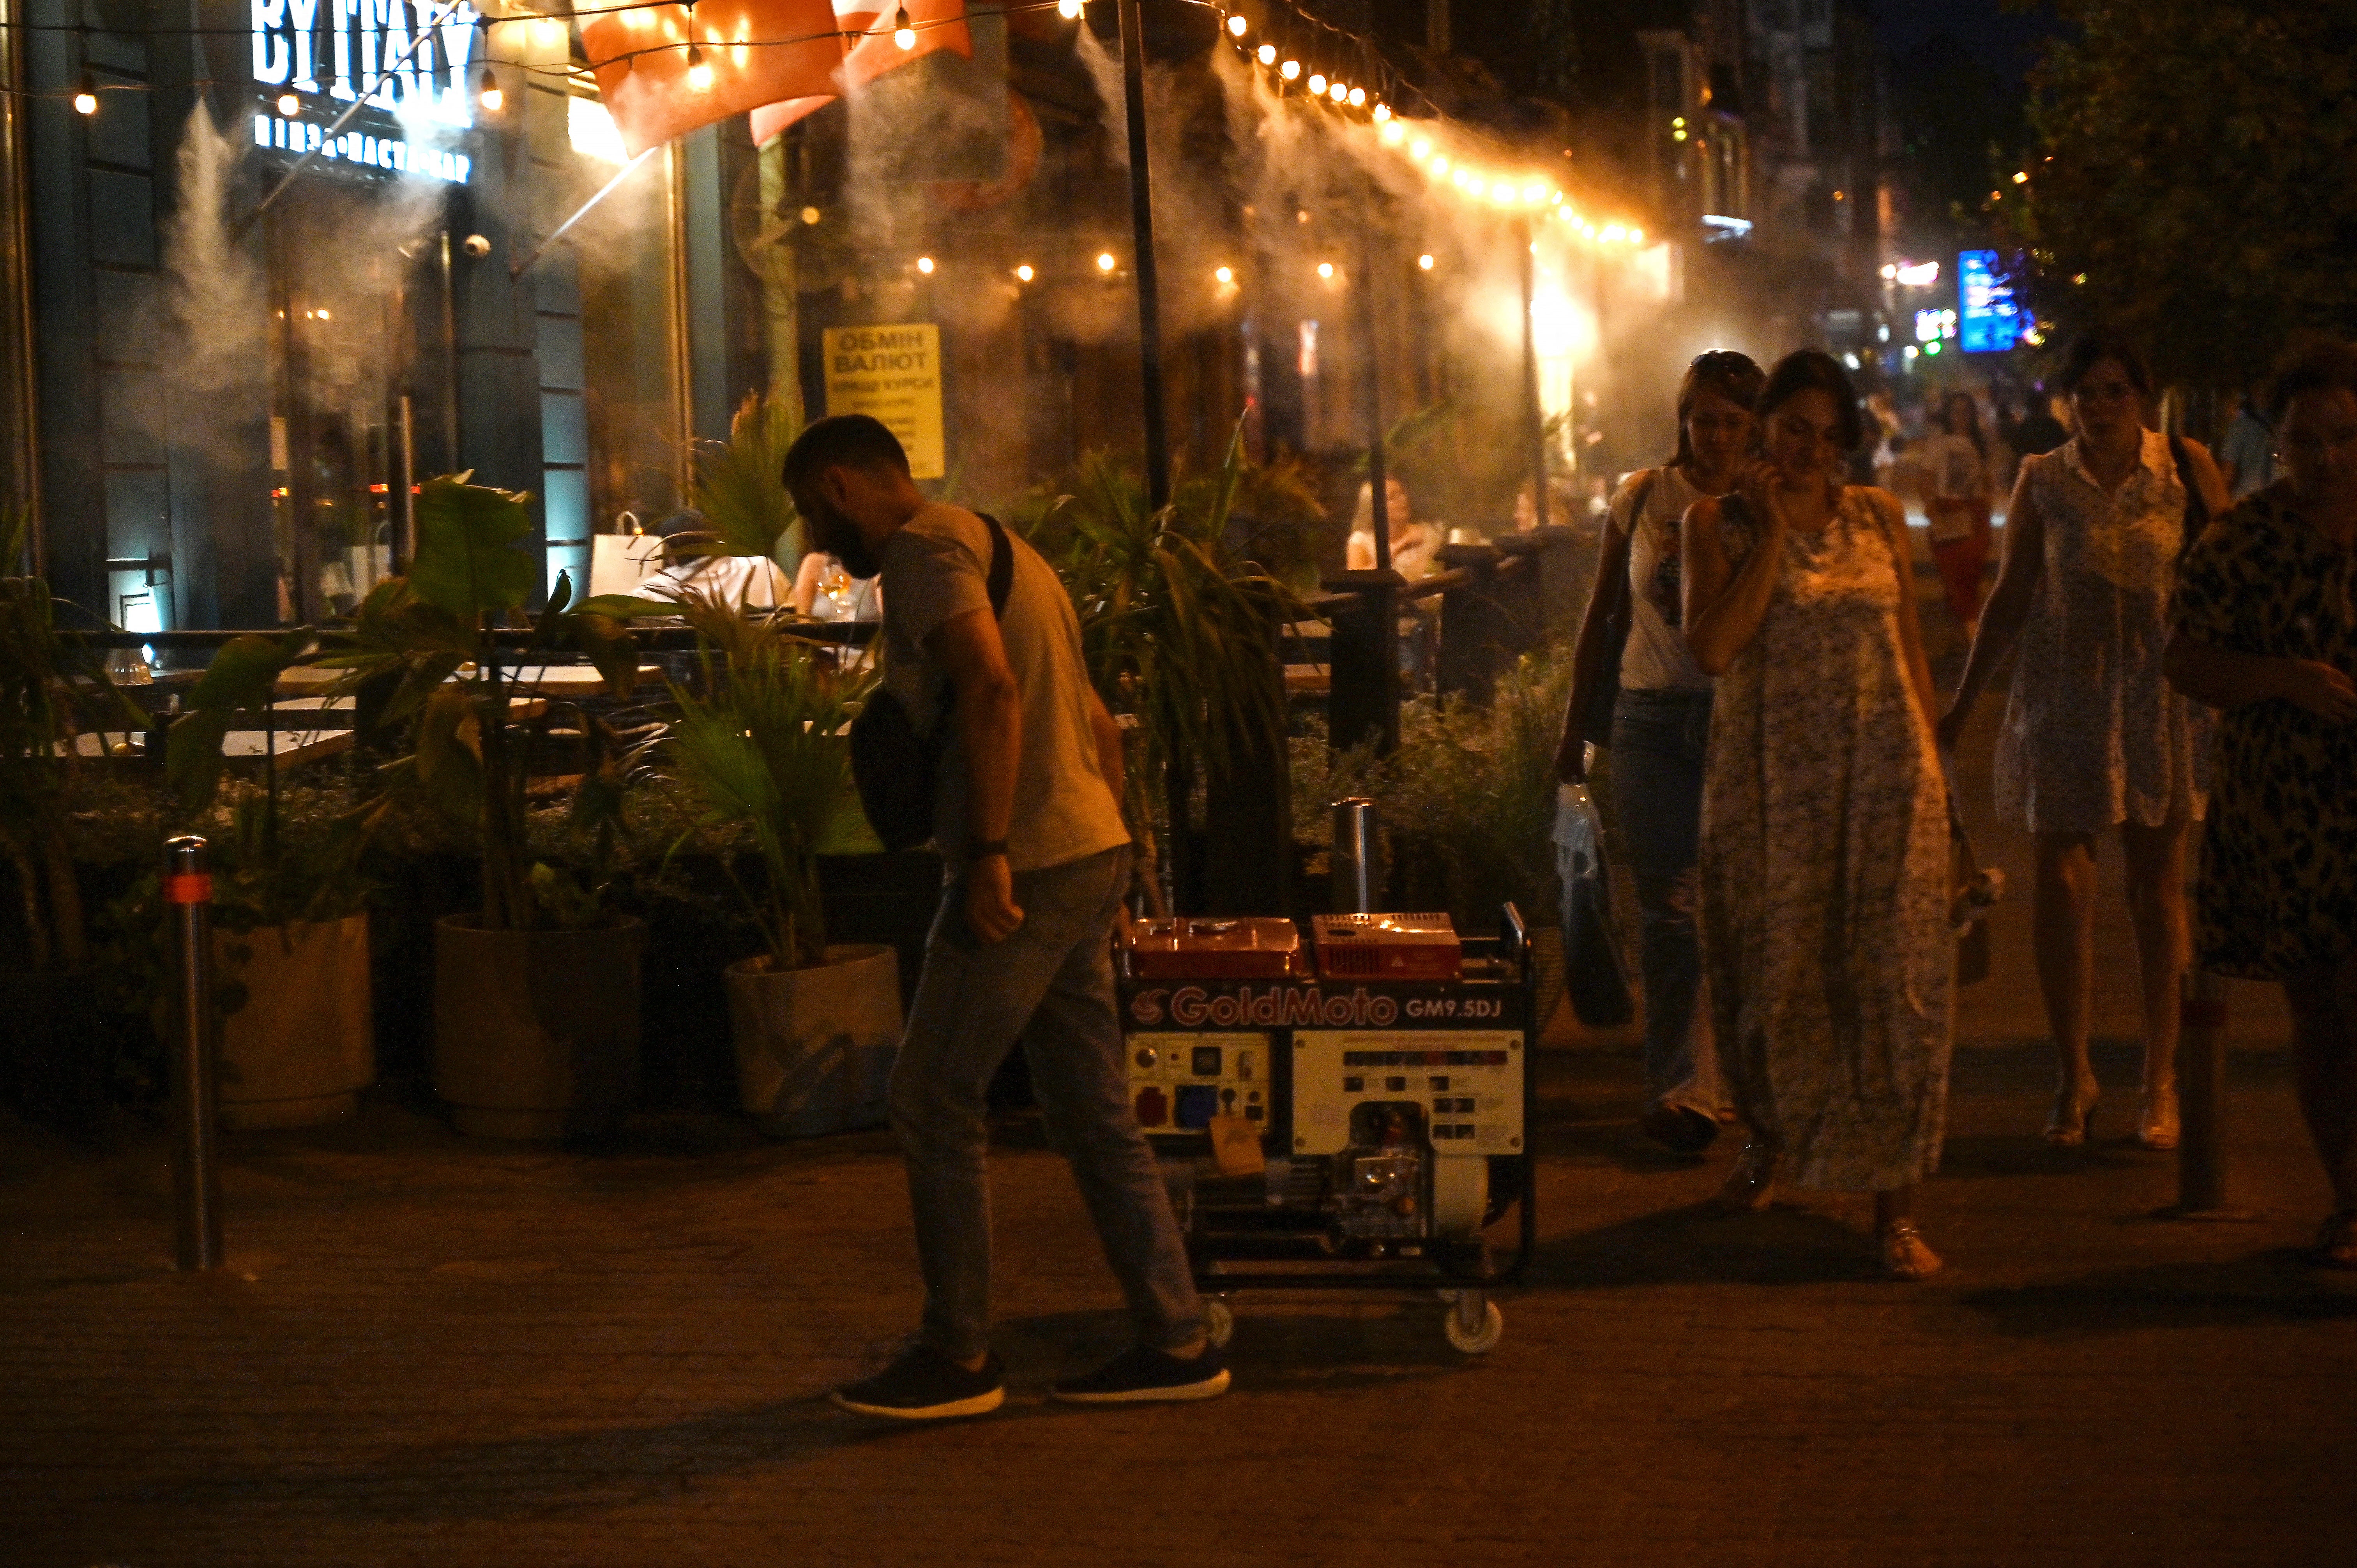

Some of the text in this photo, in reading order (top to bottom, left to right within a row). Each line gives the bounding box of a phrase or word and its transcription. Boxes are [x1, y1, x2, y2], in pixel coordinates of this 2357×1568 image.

[839, 331, 923, 351] ОБМІН
[835, 352, 928, 373] ВАЛЮТ
[1171, 986, 1398, 1026] GoldMoto
